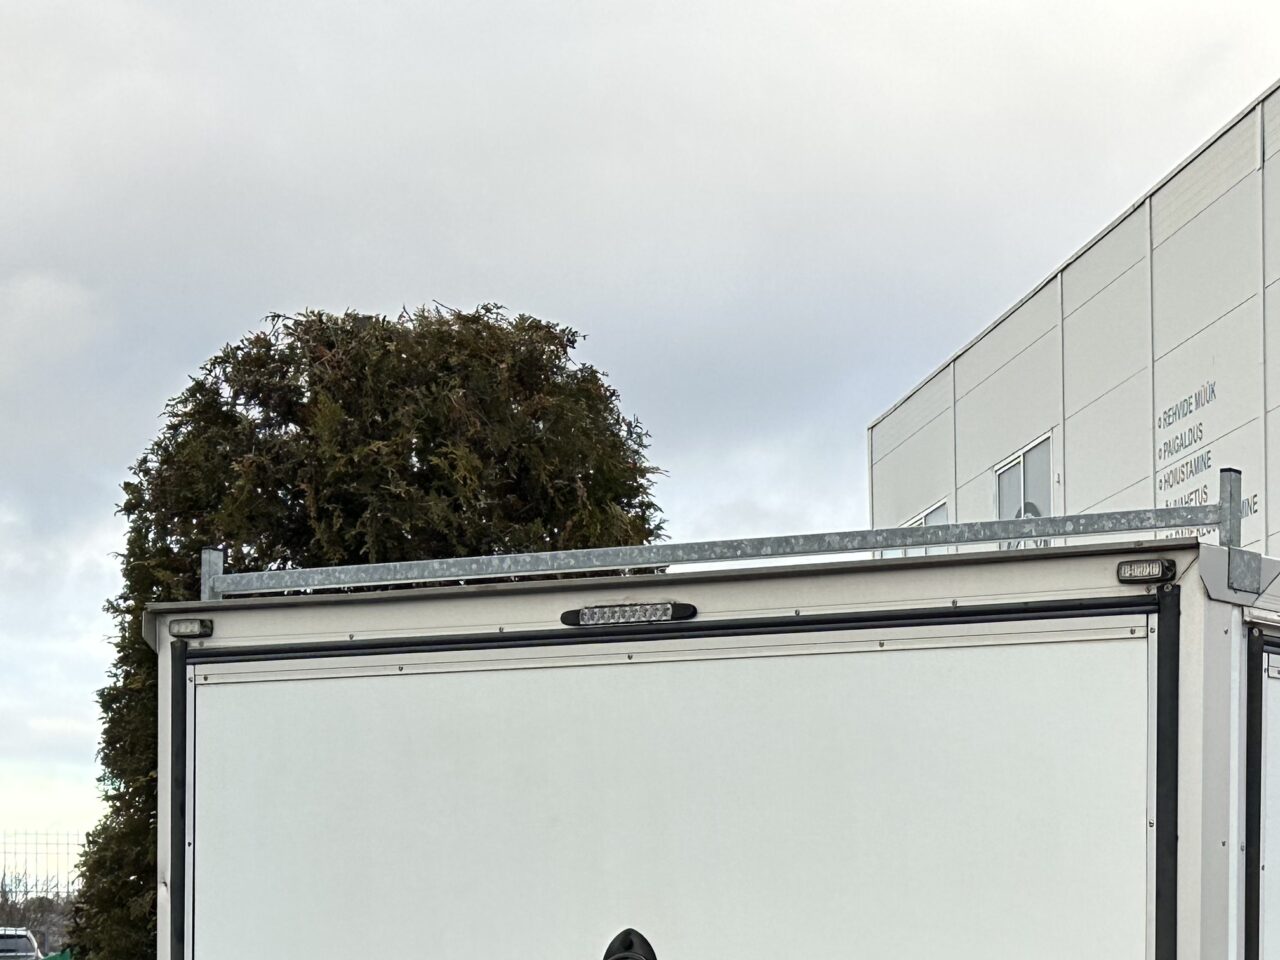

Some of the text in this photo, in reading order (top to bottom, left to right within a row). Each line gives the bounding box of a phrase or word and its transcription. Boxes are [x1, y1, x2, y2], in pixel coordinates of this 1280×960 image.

[1162, 380, 1217, 430] REHVIDE MÜÜK
[1163, 422, 1203, 460] PAIGALDUS
